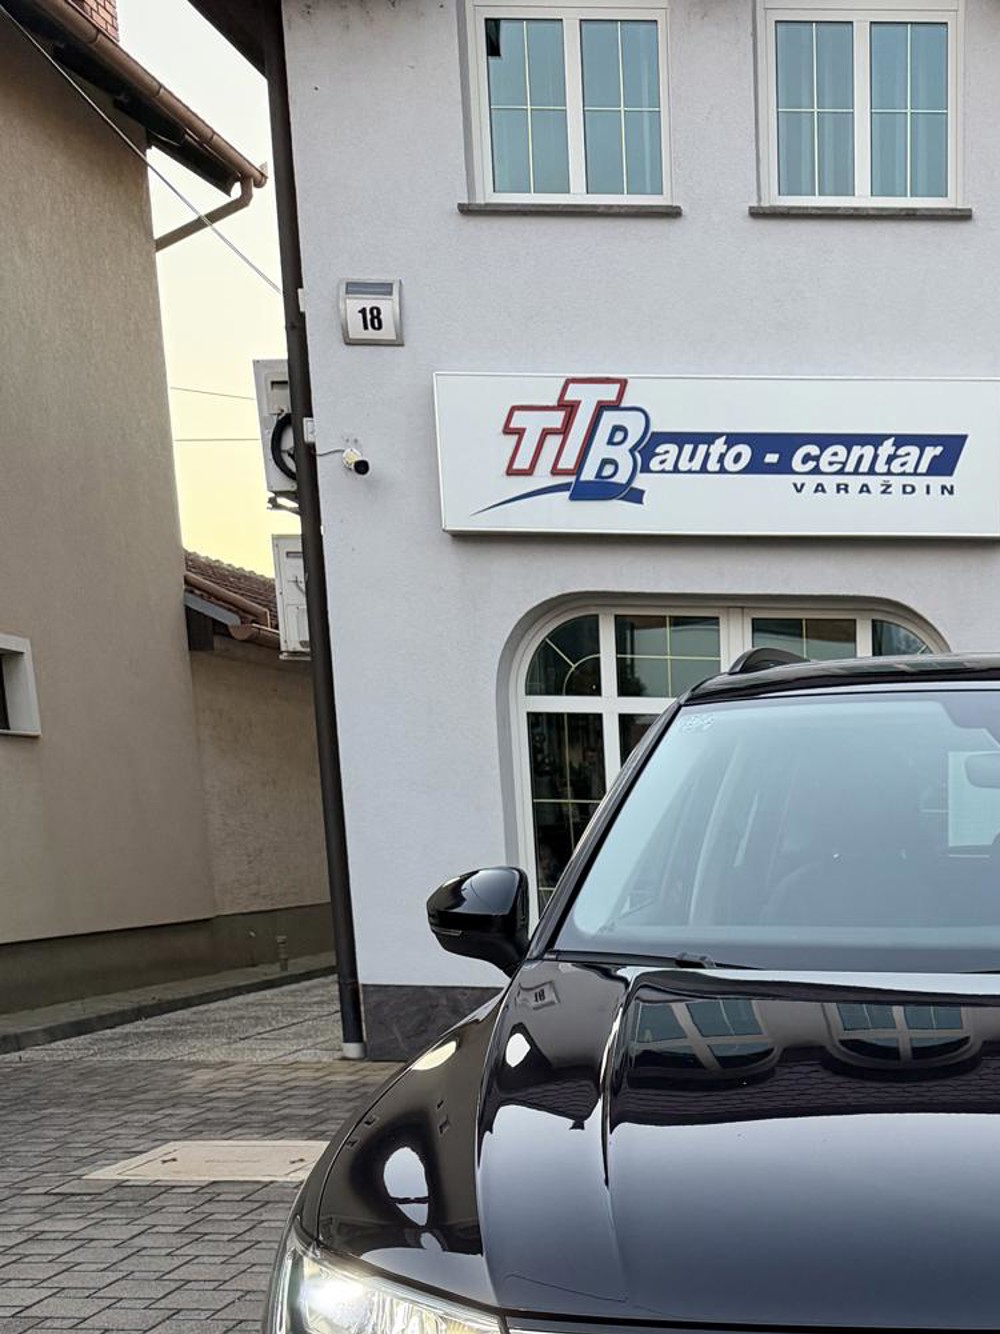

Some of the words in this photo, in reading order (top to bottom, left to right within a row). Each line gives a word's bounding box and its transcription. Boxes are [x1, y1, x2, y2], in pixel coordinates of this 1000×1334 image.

[358, 306, 383, 331] 18
[502, 377, 651, 502] TTB
[649, 435, 752, 473] auto
[791, 437, 943, 475] centar
[791, 480, 956, 496] VARAŽDIN
